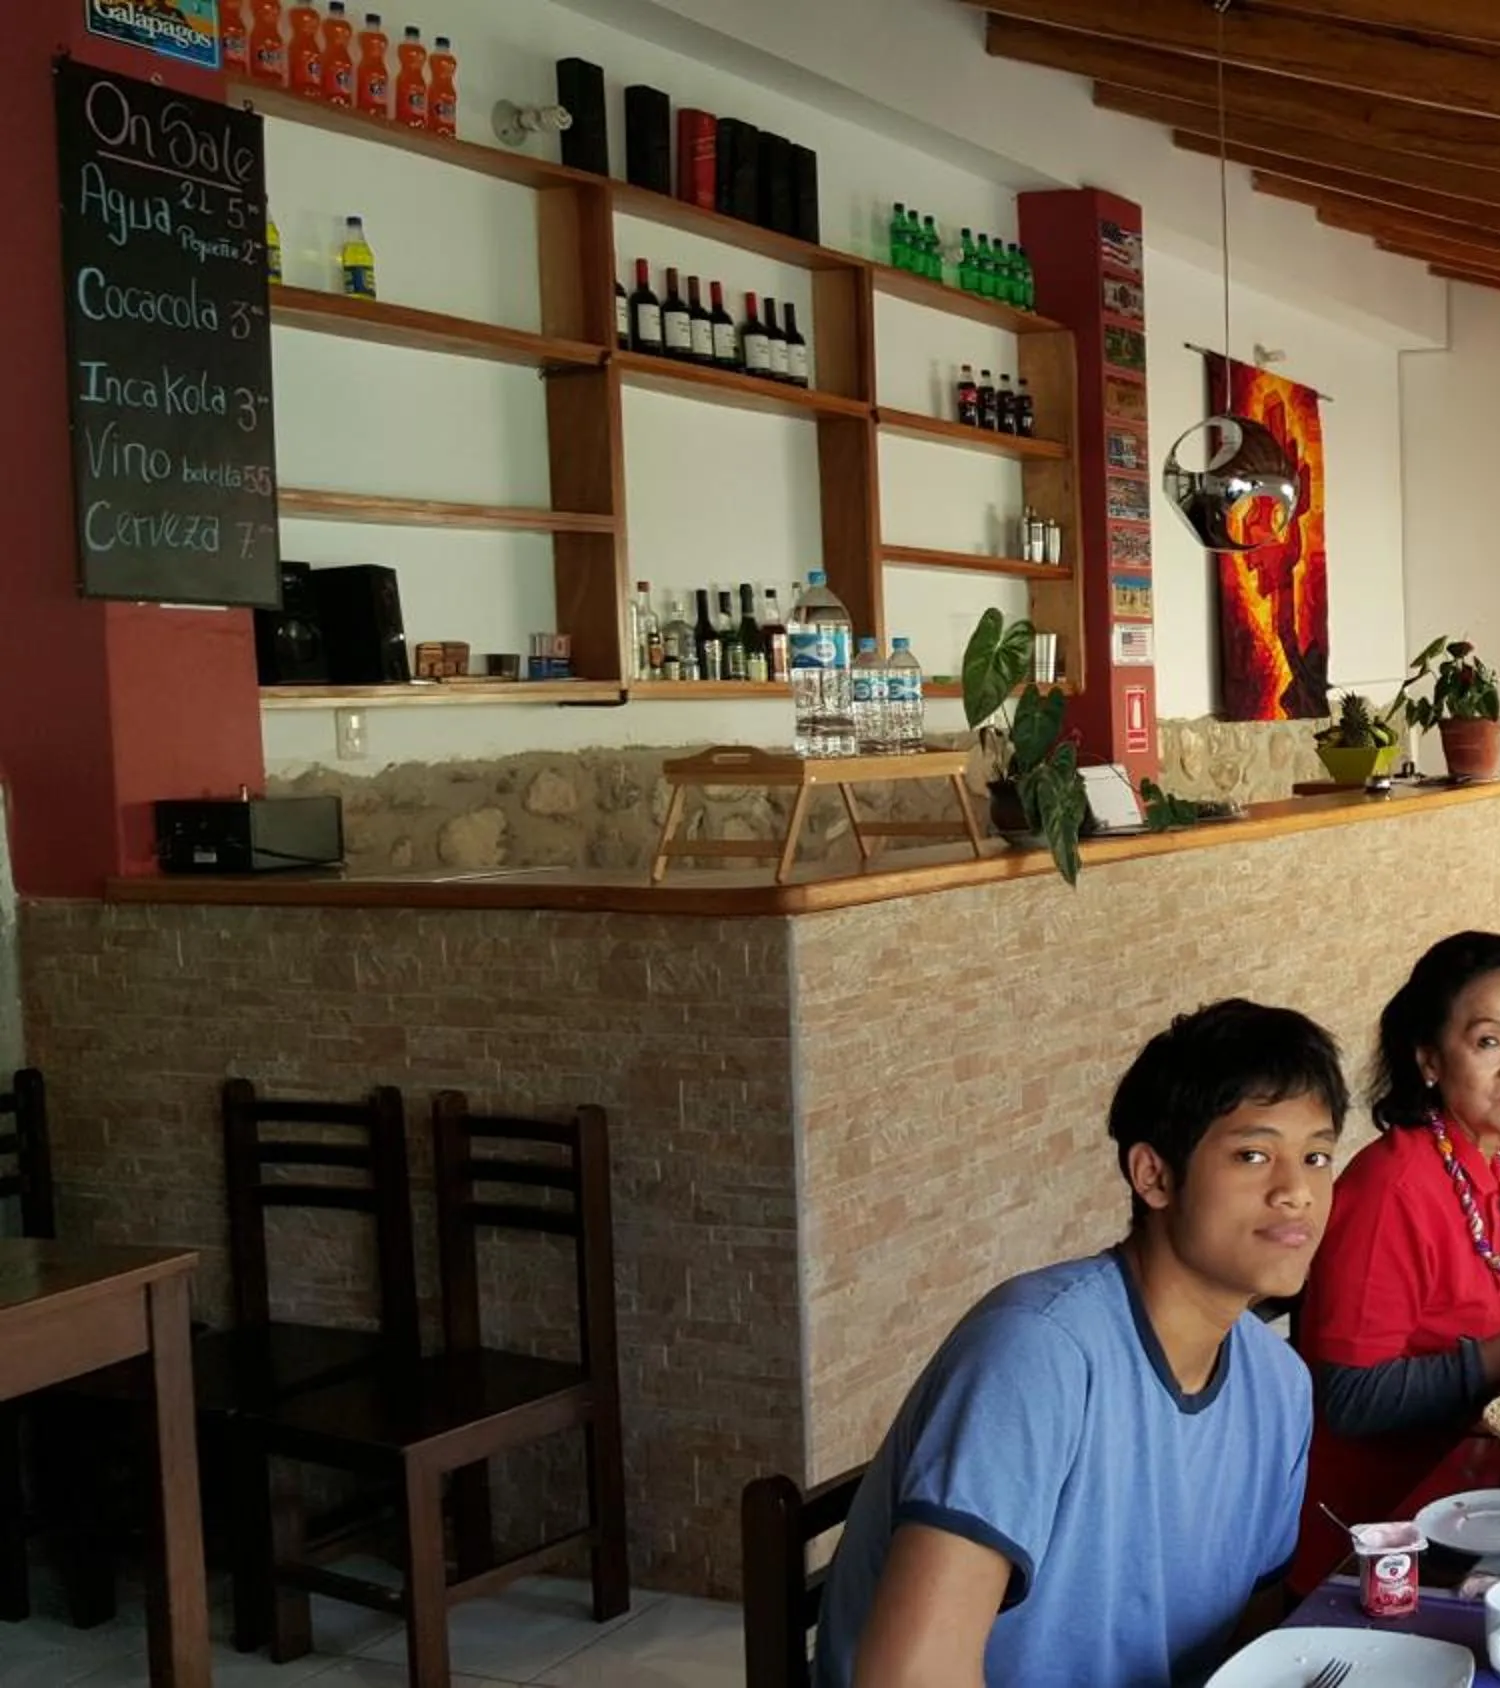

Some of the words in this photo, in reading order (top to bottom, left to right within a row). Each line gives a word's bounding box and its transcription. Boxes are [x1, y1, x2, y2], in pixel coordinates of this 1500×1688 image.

[86, 81, 156, 158] On
[160, 102, 254, 185] Sale
[81, 161, 171, 246] Agua
[78, 266, 218, 331] Cocacola
[85, 421, 171, 483] Vino
[85, 500, 220, 552] Cerveza
